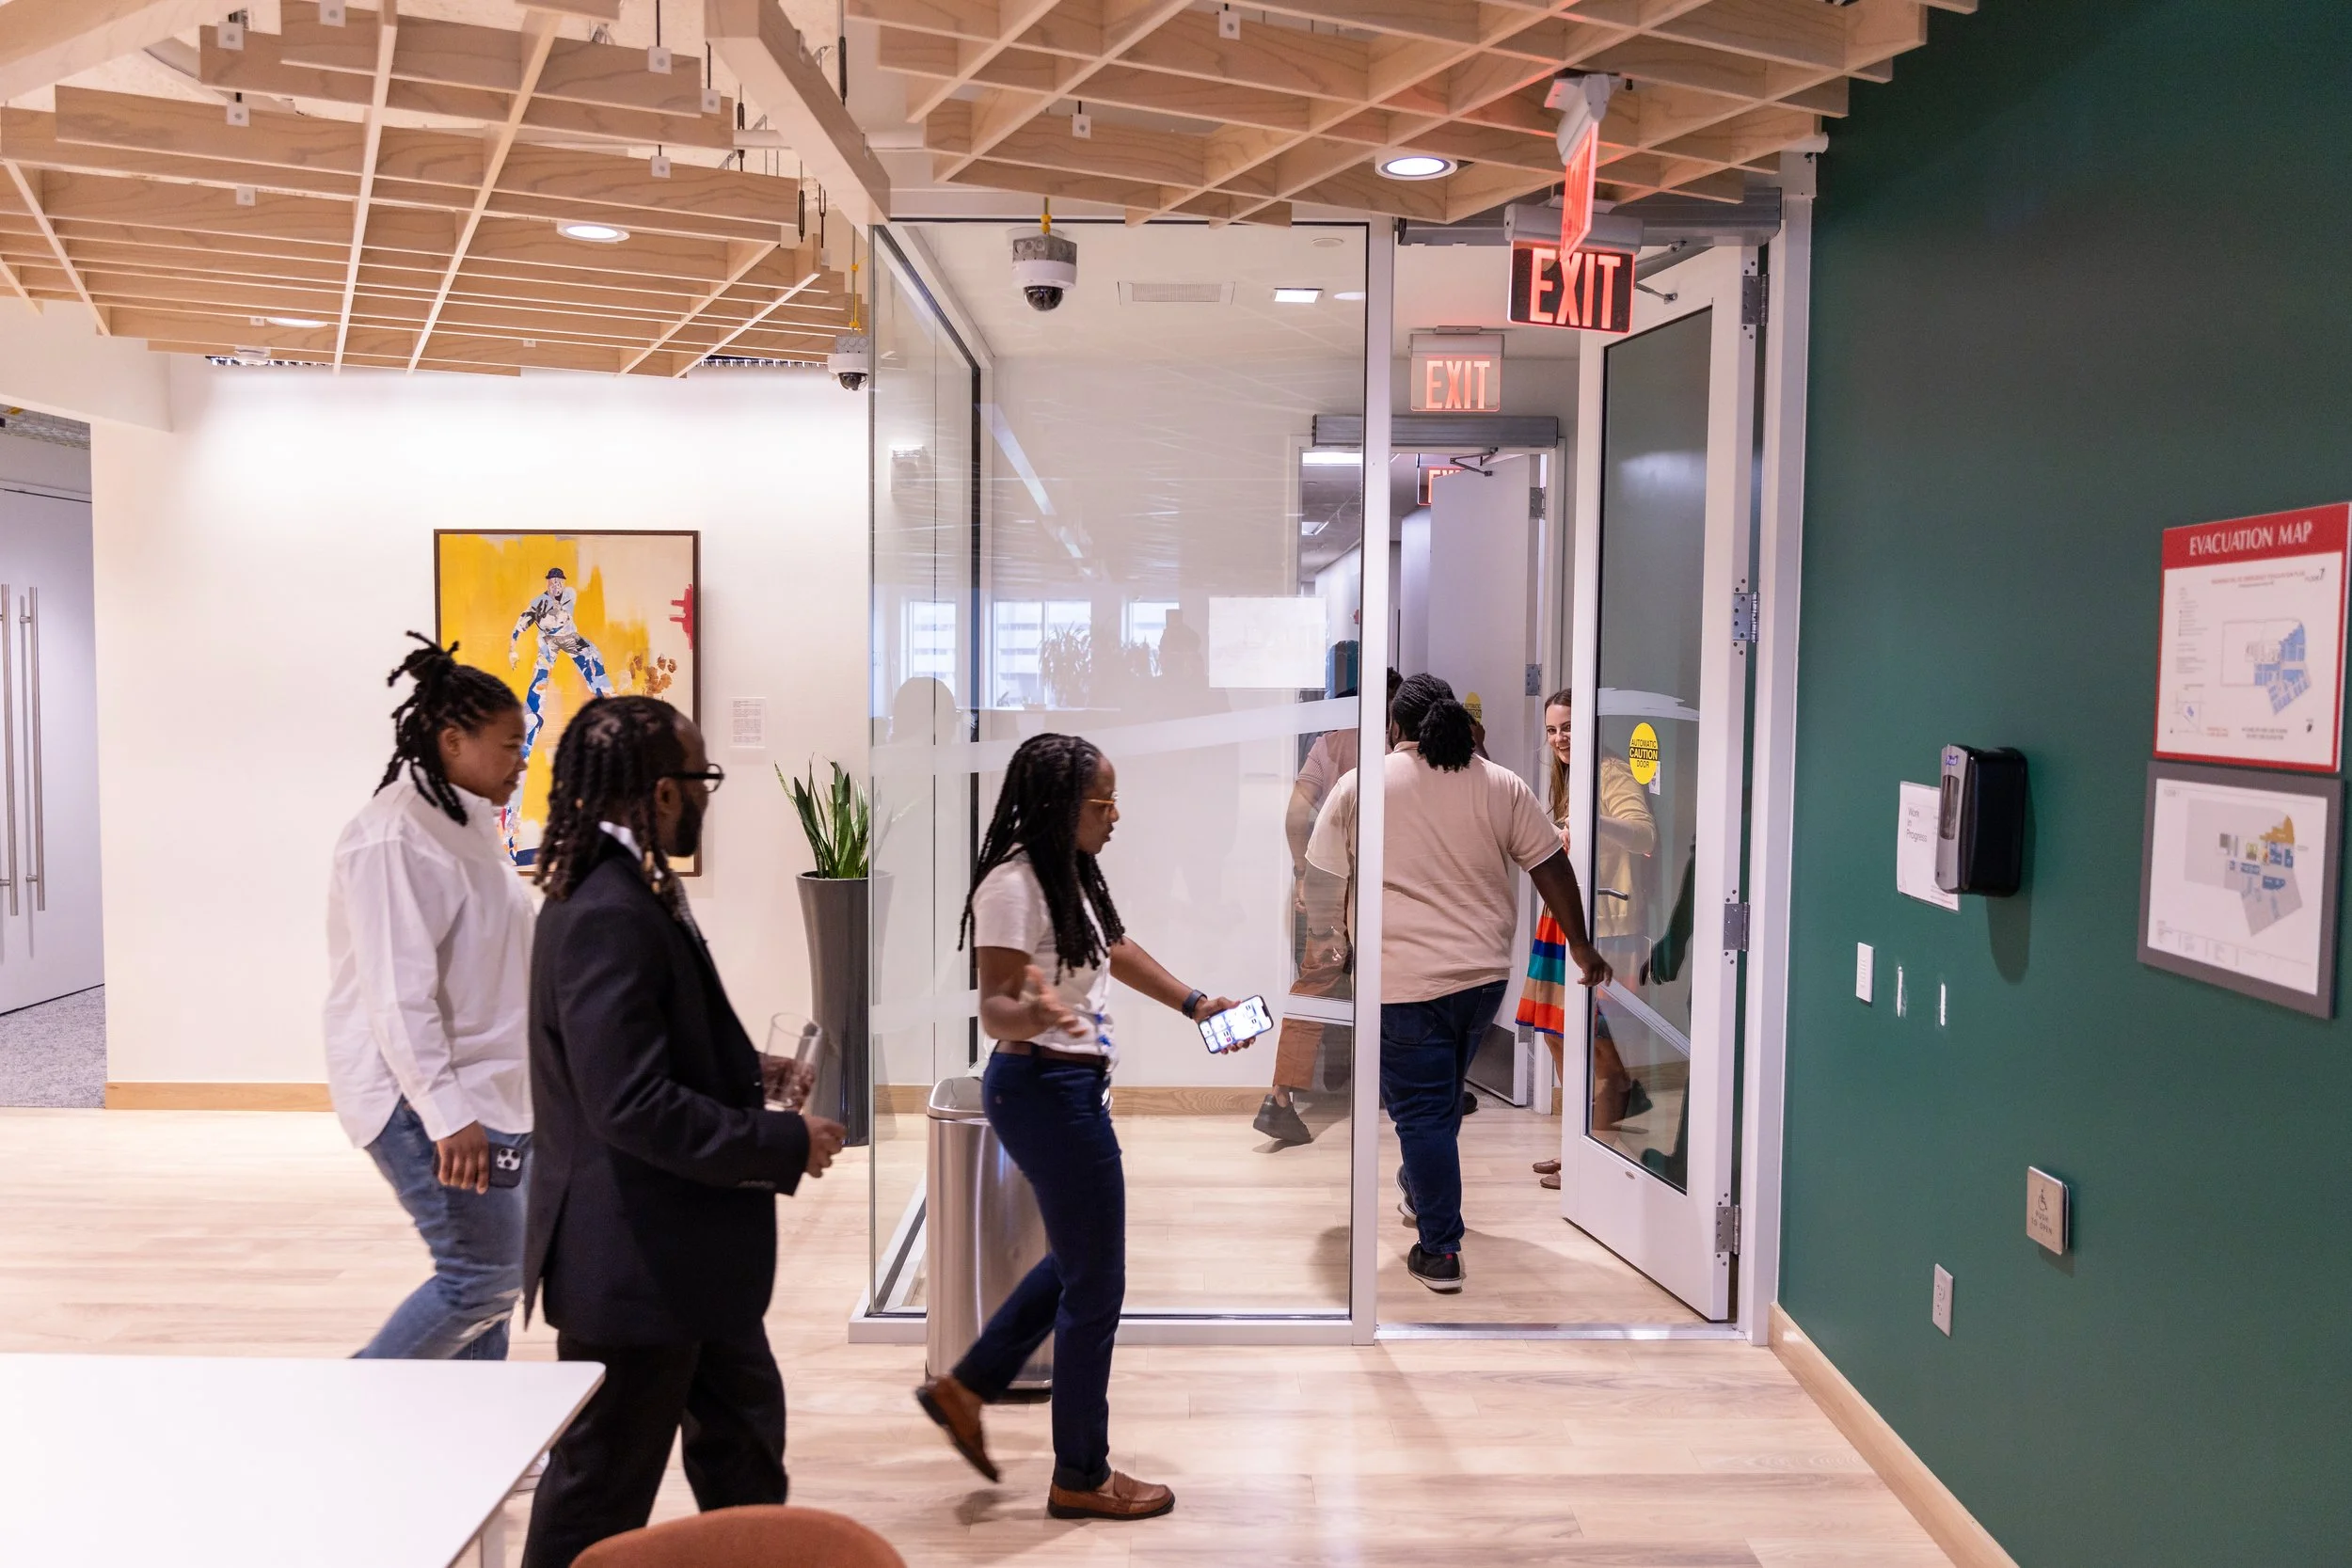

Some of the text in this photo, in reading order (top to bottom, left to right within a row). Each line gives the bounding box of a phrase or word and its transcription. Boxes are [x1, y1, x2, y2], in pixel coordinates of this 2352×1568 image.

[1529, 246, 1622, 330] EXIT
[1425, 360, 1490, 409] EXIT
[2189, 521, 2312, 556] EVACUATION MAP
[1631, 738, 1657, 749] AUTOMATIC
[1629, 748, 1658, 760] CAUTION
[1908, 807, 1920, 818] Work
[1906, 829, 1928, 843] Progress
[2035, 1210, 2048, 1221] PUSH
[2039, 1222, 2053, 1235] OPEN
